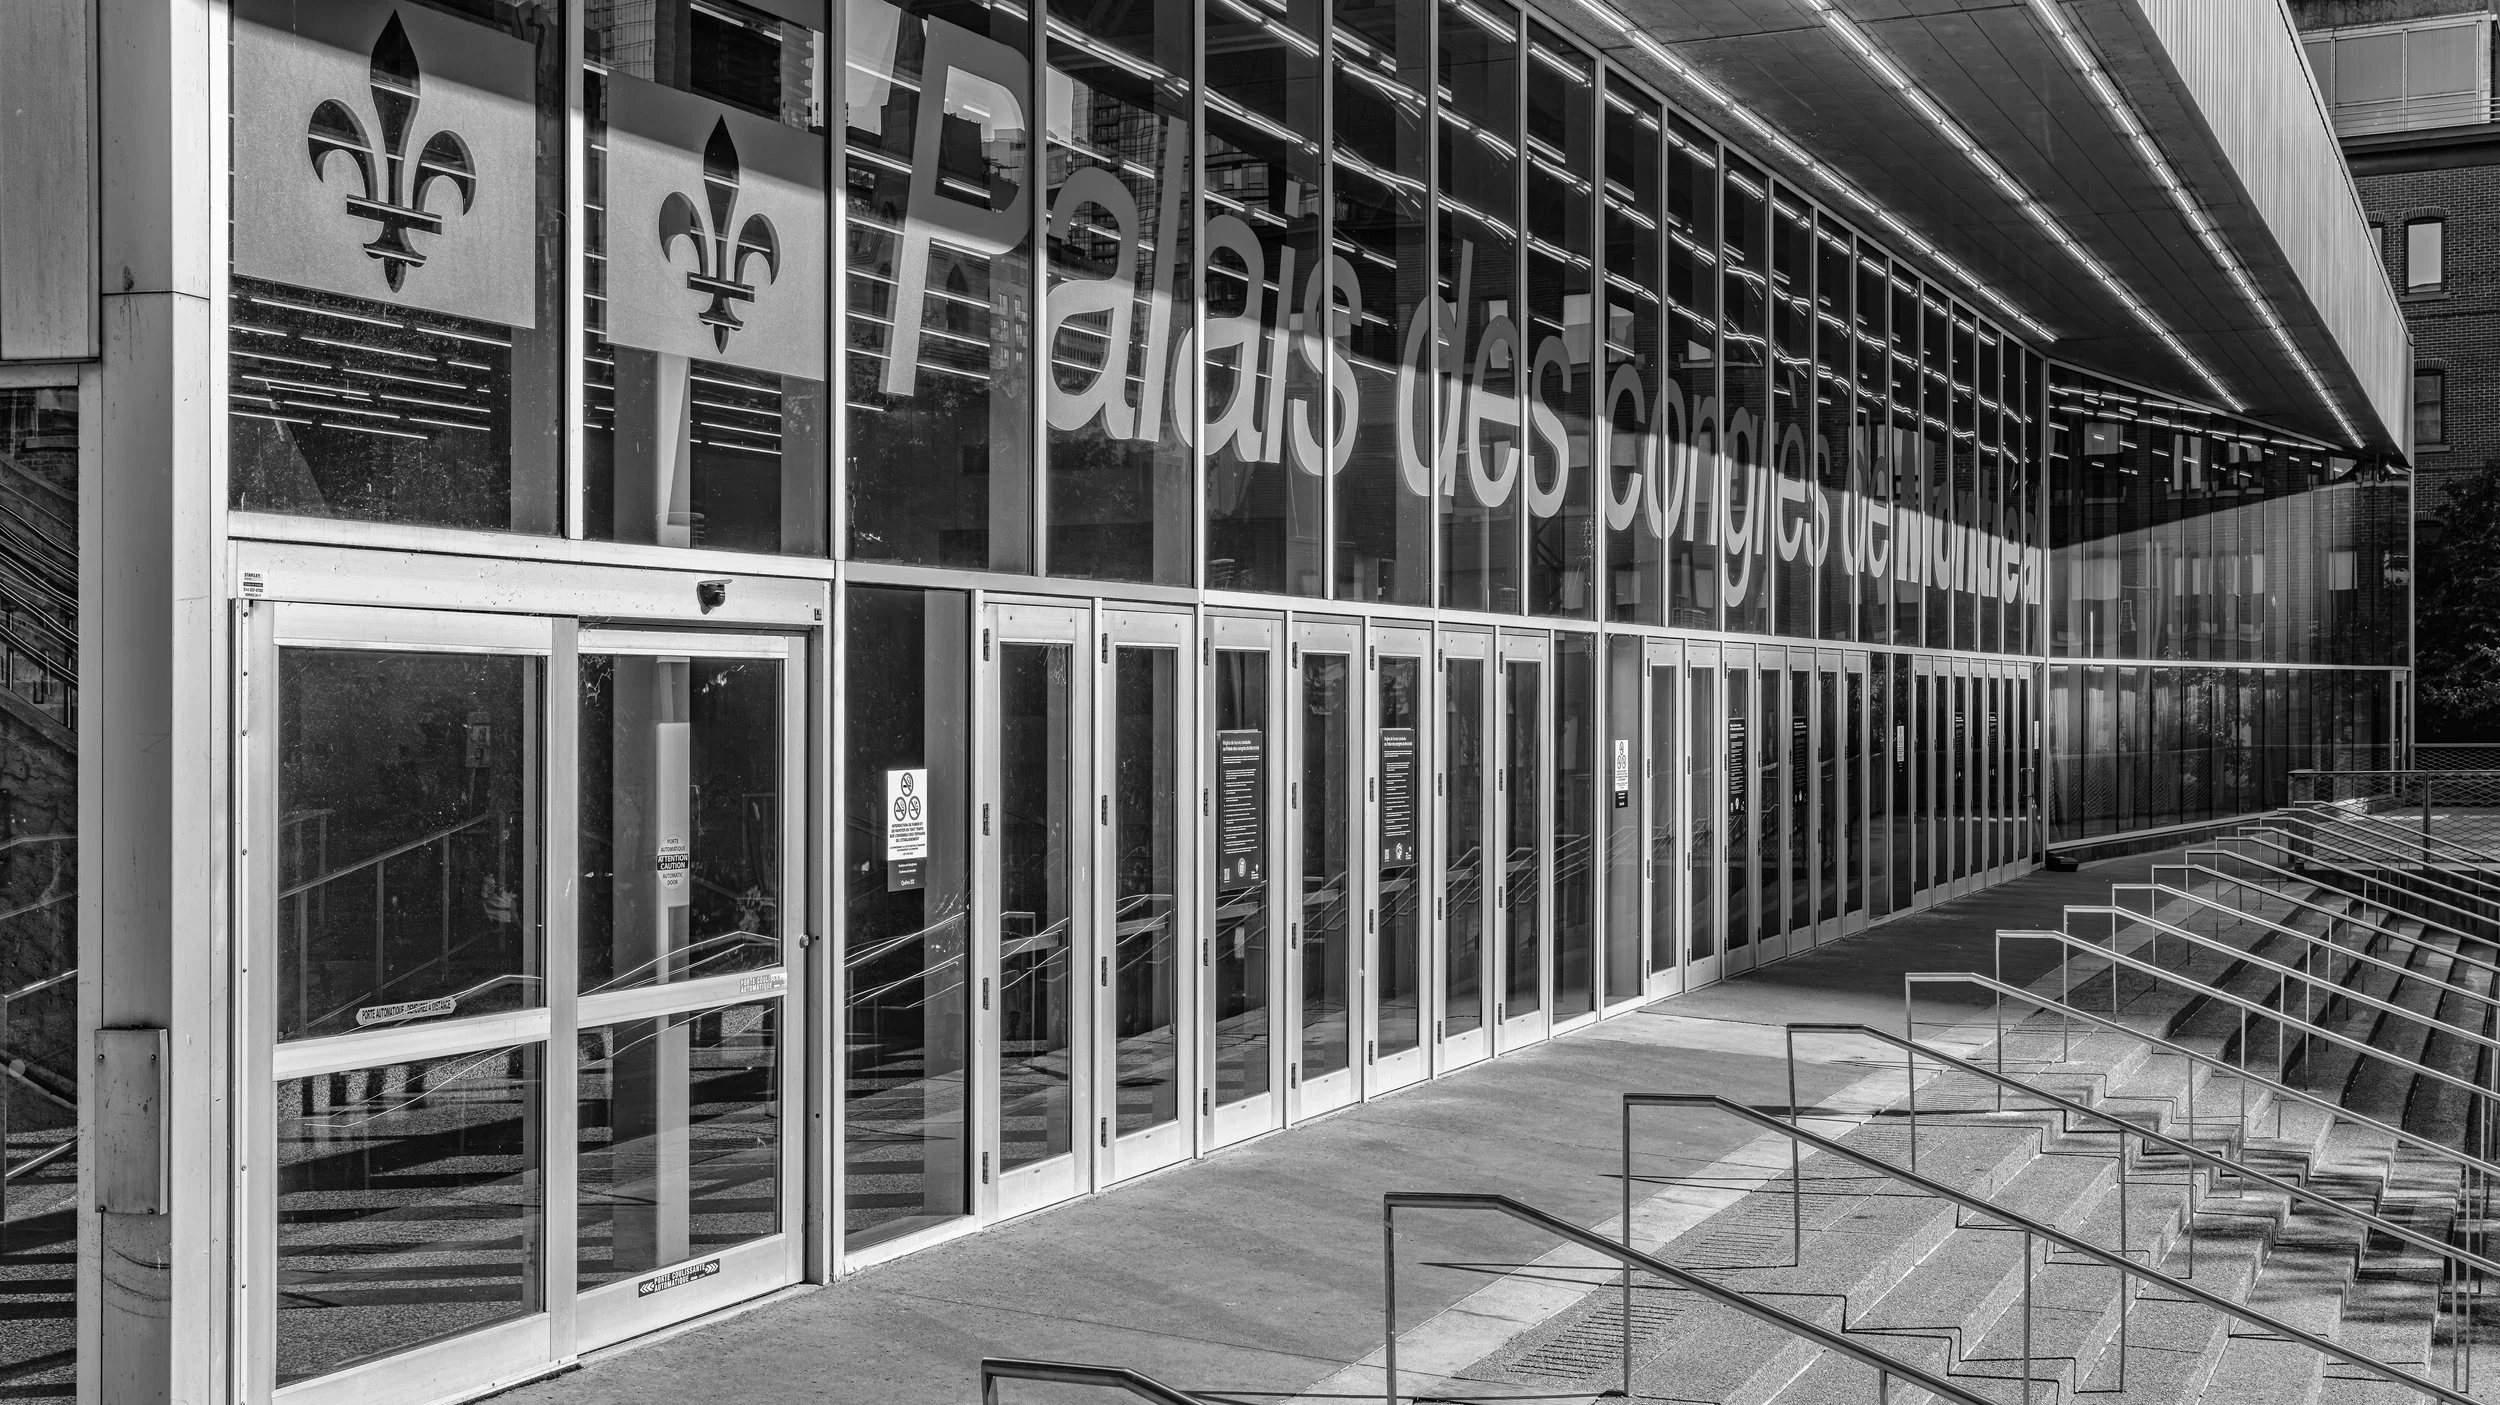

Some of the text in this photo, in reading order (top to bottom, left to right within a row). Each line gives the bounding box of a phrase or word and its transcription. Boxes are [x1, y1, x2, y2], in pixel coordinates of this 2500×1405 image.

[878, 14, 2043, 608] Palais des congrès de Montréal
[657, 854, 688, 863] ATTENTION
[660, 862, 686, 870] CAUTION
[740, 977, 756, 987] PORTE
[740, 982, 773, 993] AUTOMATIQUE
[362, 1009, 375, 1020] PORTE
[431, 999, 451, 1011] DISTANCE
[653, 1272, 671, 1285] PORTE
[671, 1262, 706, 1280] COULISSANTE
[654, 1274, 690, 1293] AUTOMATIQUE
